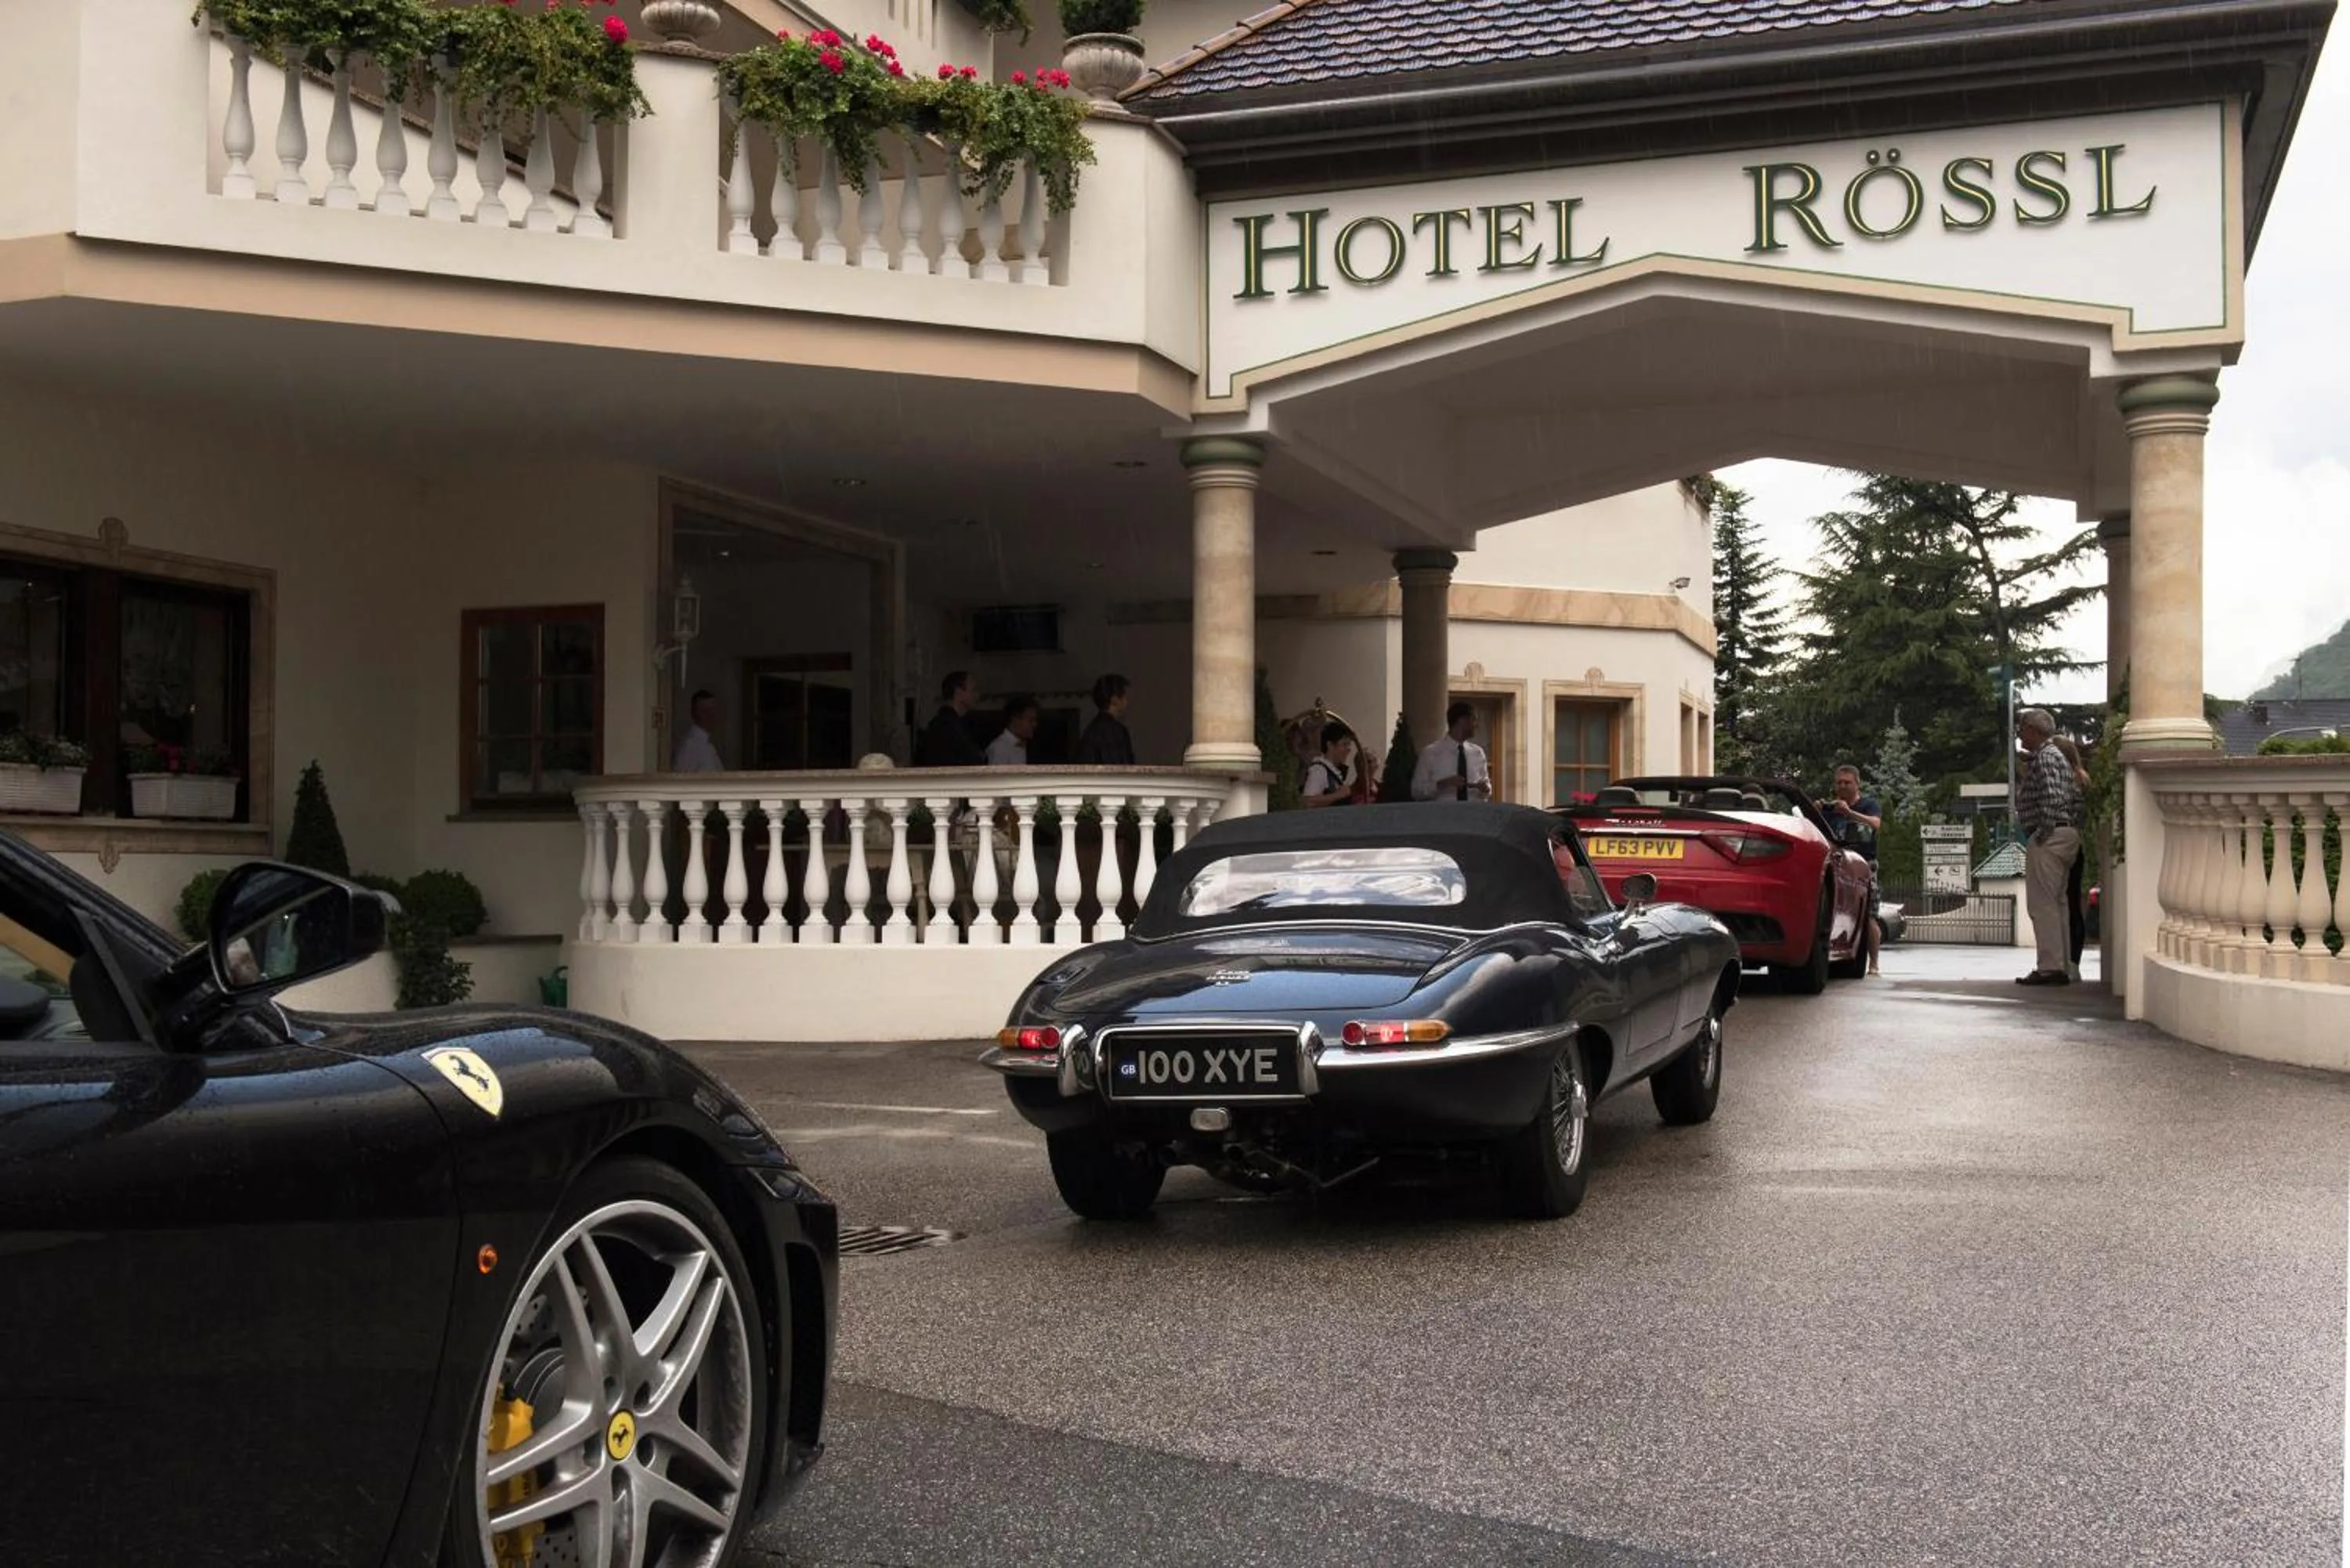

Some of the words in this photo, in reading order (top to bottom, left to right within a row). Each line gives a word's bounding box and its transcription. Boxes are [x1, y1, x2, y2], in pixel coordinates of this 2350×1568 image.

[1232, 197, 1610, 299] HOTEL
[1741, 143, 2157, 252] RÖSSL
[1595, 839, 1640, 855] LF63
[1643, 840, 1676, 857] PVV
[1121, 1064, 1136, 1075] GB
[1138, 1050, 1195, 1085] 100
[1203, 1048, 1279, 1084] XYE
